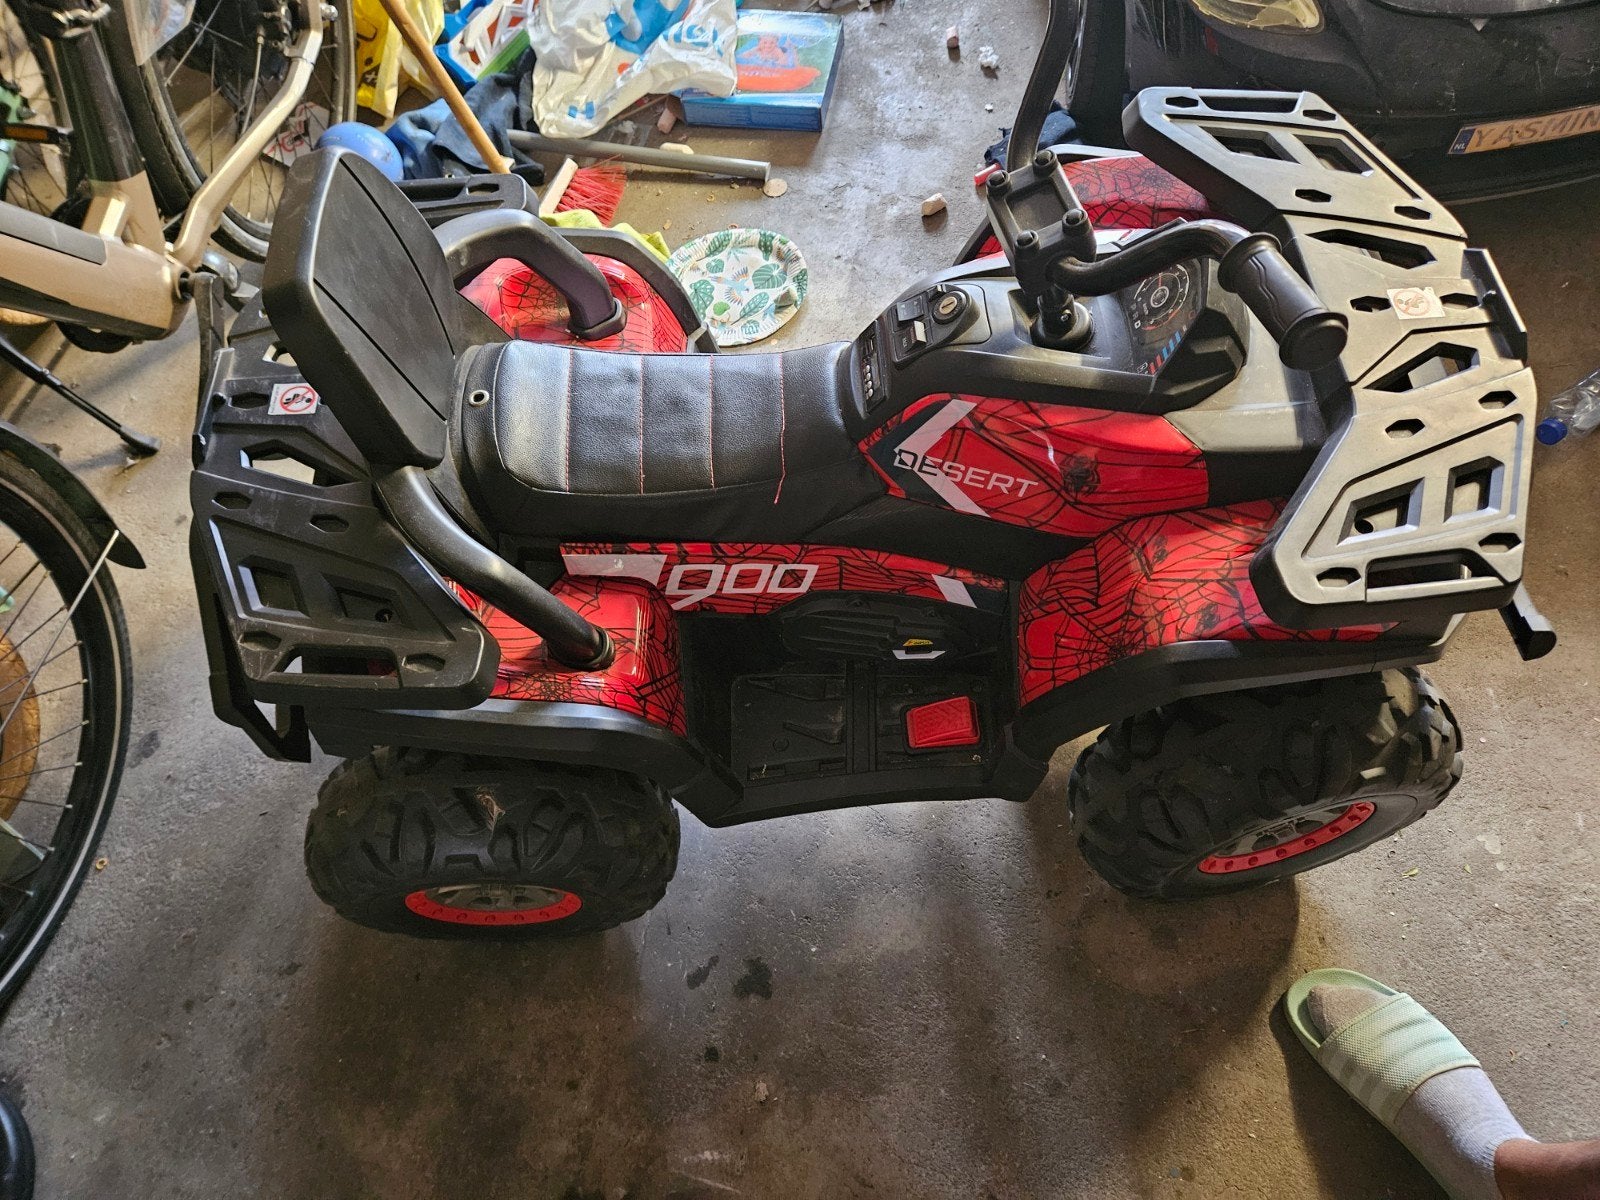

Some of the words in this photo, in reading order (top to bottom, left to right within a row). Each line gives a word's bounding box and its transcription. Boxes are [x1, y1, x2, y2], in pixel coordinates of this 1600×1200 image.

[1454, 142, 1466, 151] NL
[893, 448, 1039, 498] DESERT
[665, 563, 819, 611] 900
